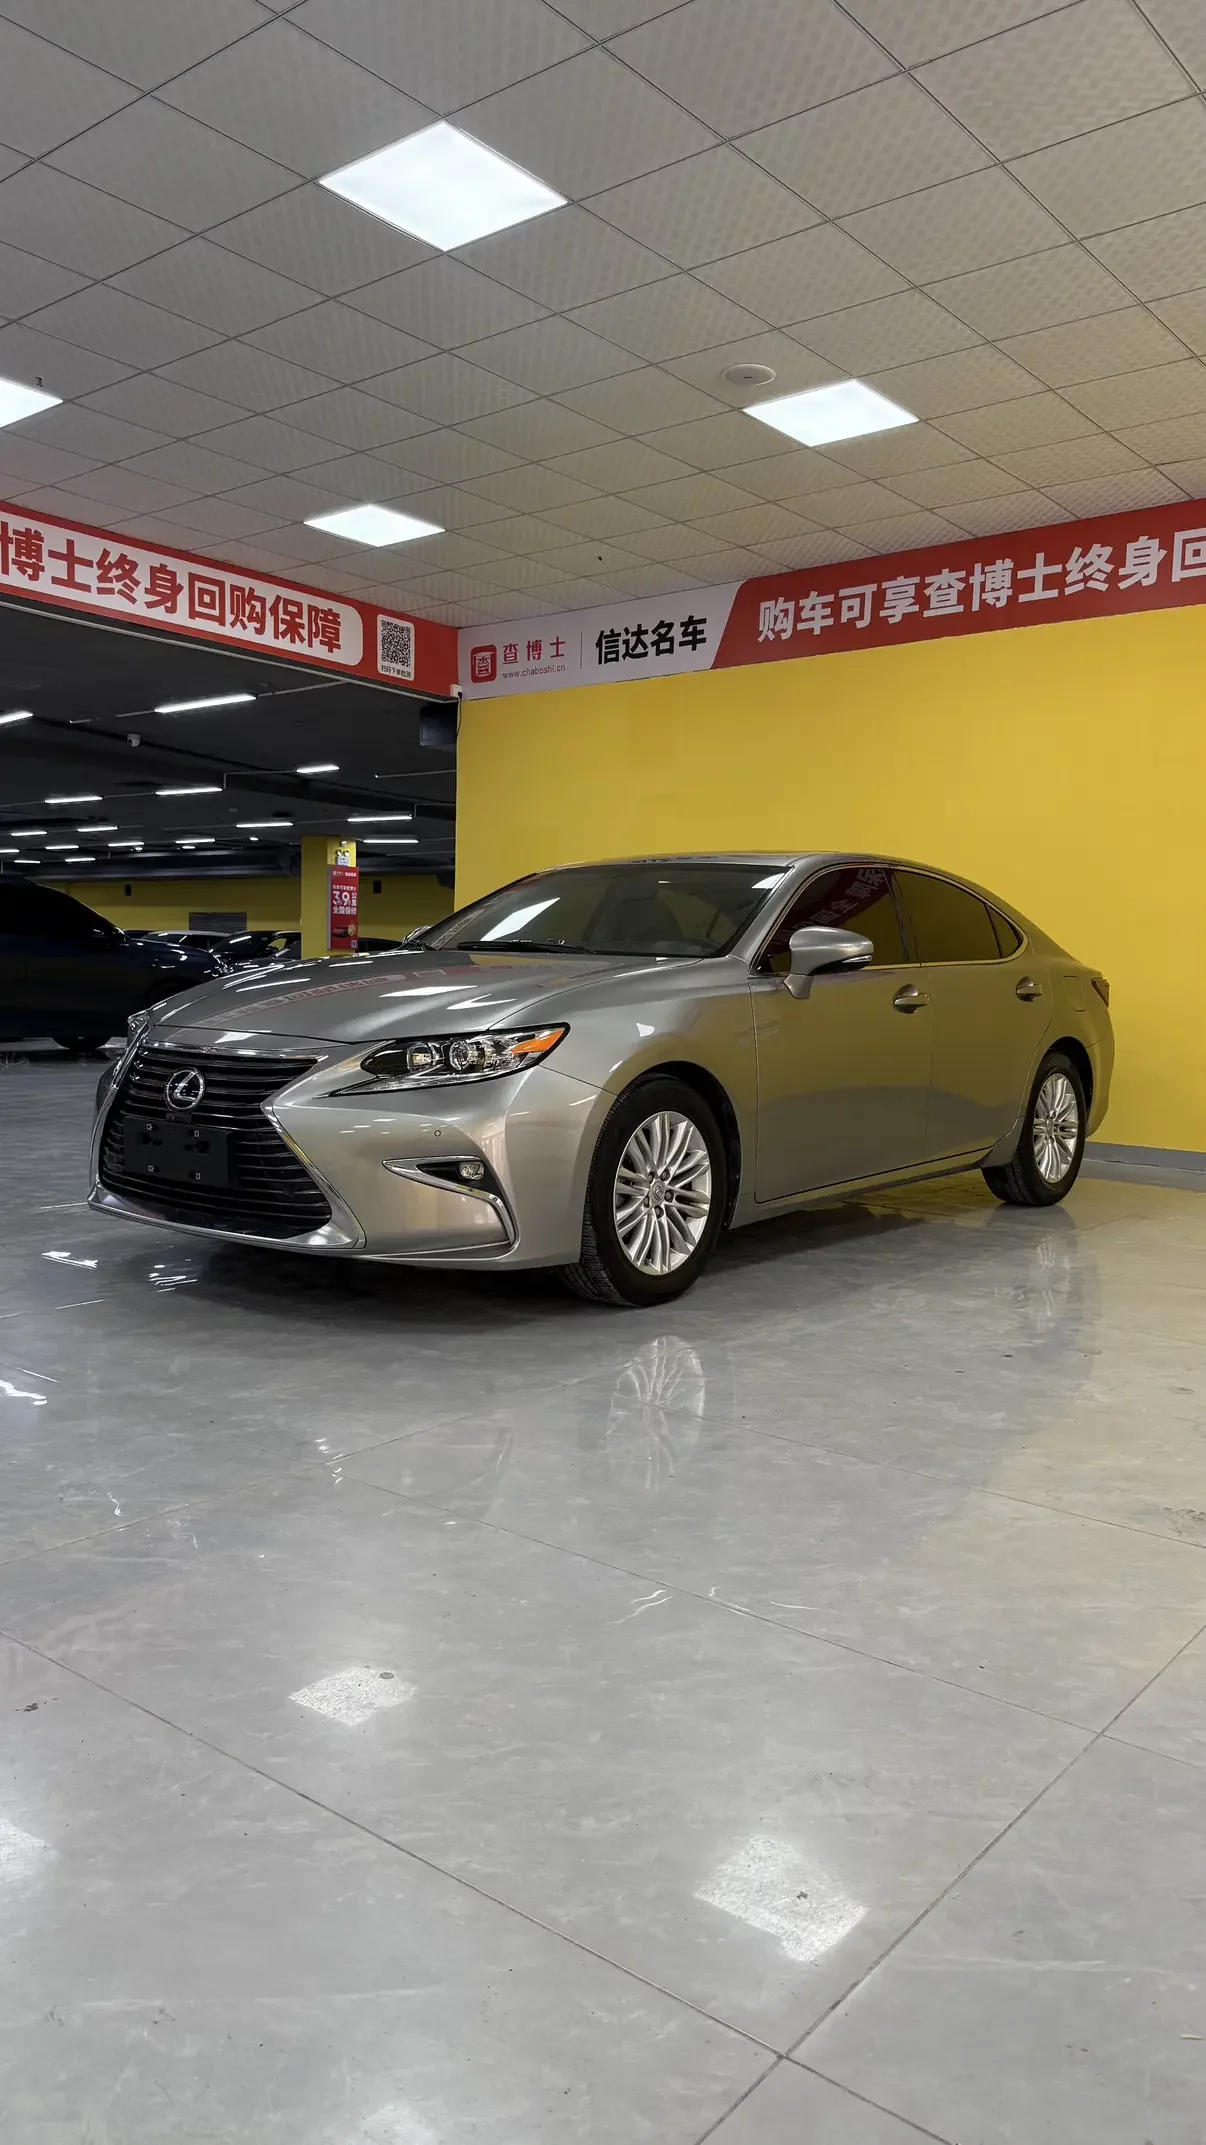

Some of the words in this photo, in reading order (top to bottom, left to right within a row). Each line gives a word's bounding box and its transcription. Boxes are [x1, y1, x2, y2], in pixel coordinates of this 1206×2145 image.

[0, 520, 342, 653] 博士终身回购保障
[757, 527, 1206, 644] 购车可享查博士终身回
[502, 636, 566, 665] 查博士
[595, 615, 707, 666] 信达名车
[502, 664, 566, 679] www.chaboshi.cn
